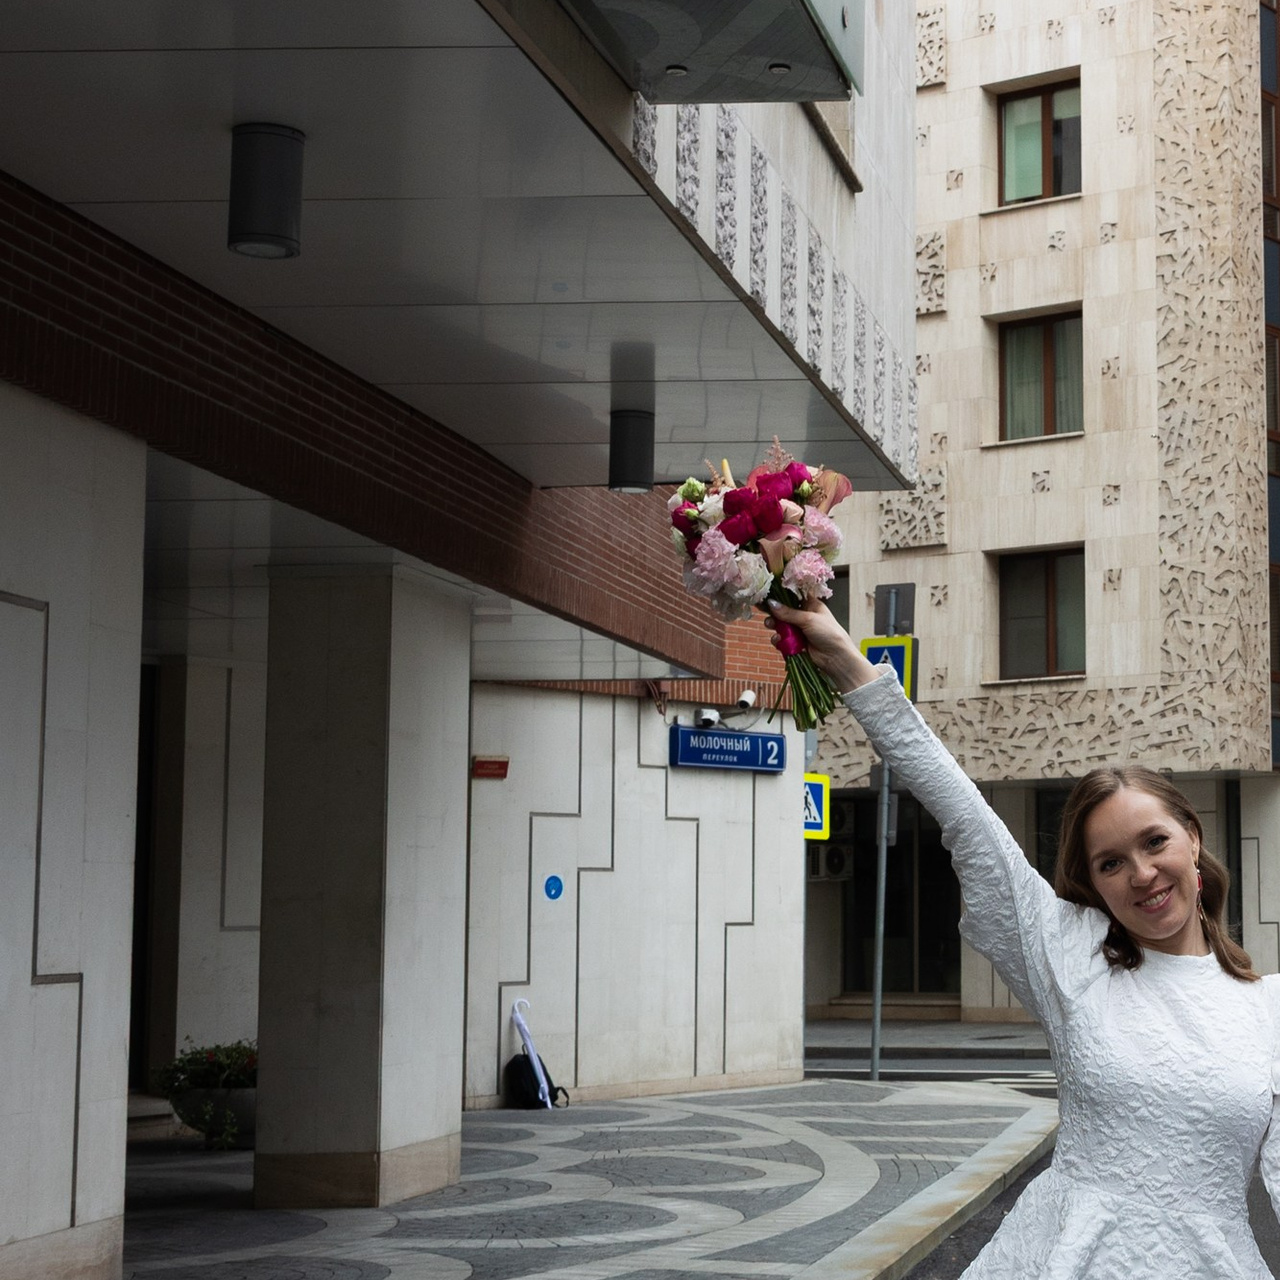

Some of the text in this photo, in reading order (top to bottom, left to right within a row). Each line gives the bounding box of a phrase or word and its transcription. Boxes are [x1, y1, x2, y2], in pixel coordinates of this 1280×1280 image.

[690, 735, 750, 751] МОЛОЧНЫЙ
[702, 753, 738, 762] ПЕРЕУЛОК
[767, 741, 778, 765] 2
